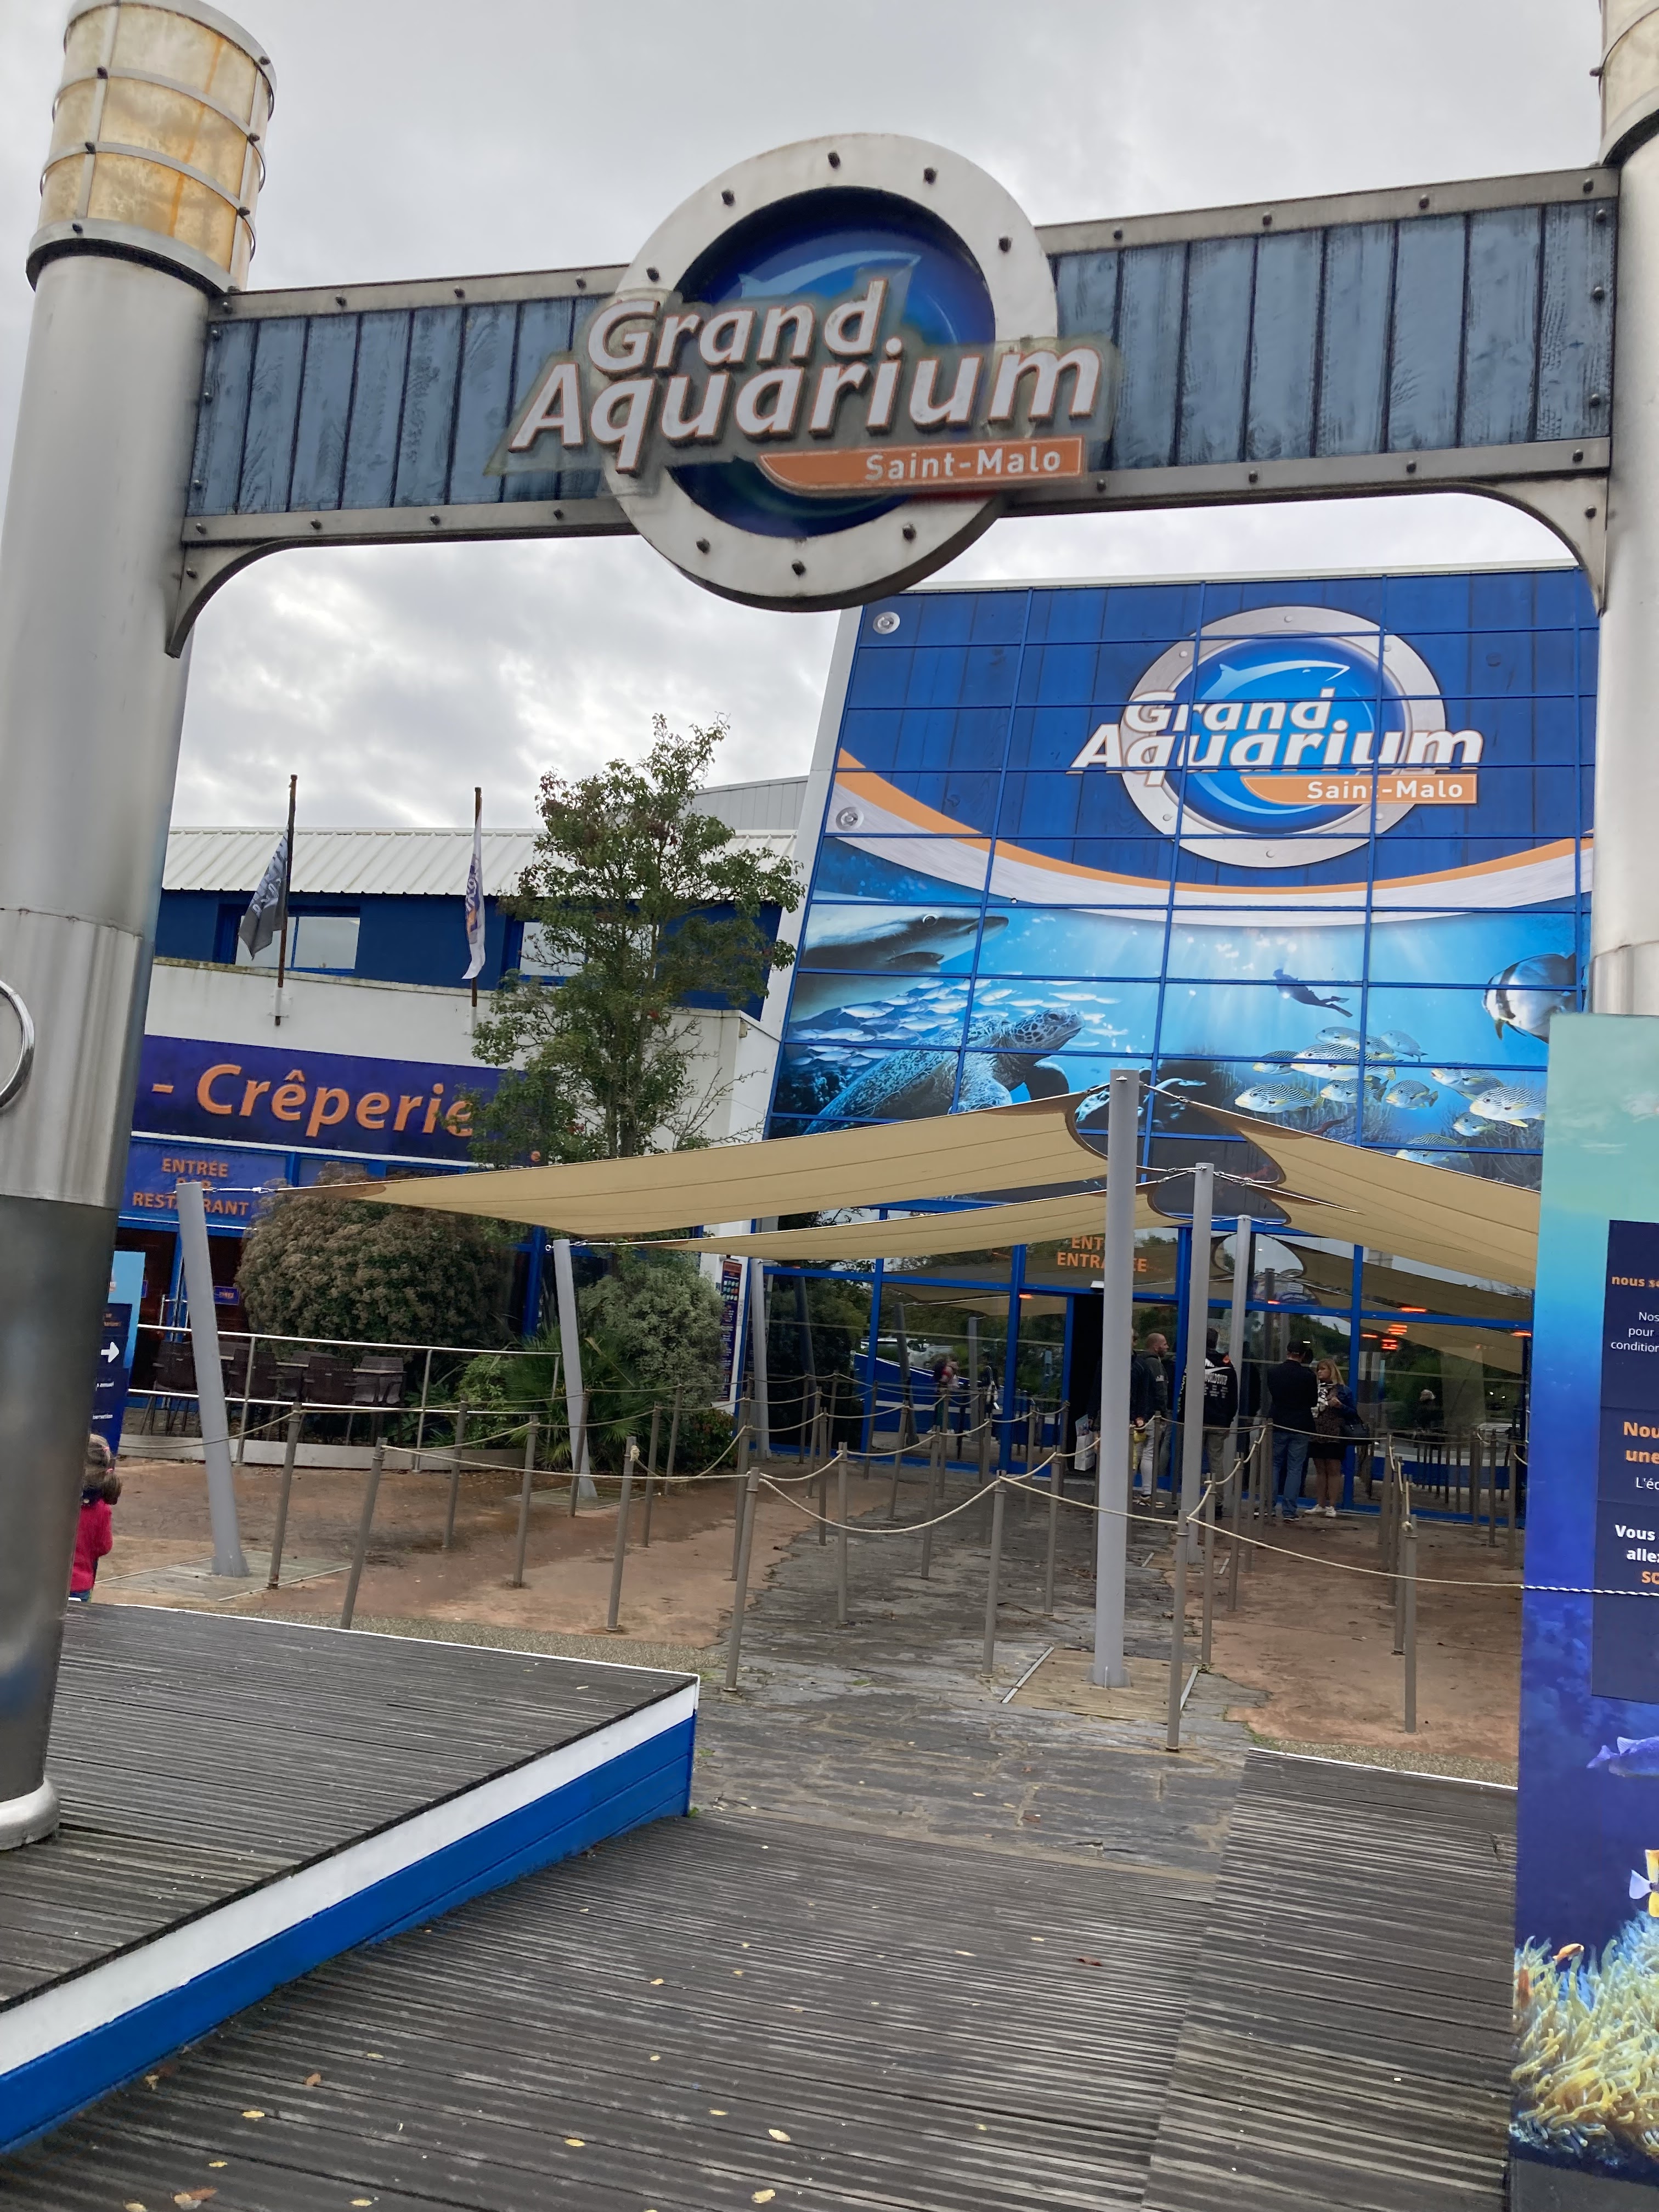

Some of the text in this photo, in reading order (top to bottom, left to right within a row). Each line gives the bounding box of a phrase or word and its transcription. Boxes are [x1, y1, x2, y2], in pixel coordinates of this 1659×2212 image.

[588, 276, 888, 375] Grand
[509, 335, 1102, 475] Aquarium
[865, 446, 1062, 482] Saint-Malo
[1124, 687, 1335, 733] Grand
[1066, 719, 1483, 787] Aquarium
[1307, 778, 1464, 800] Sain-Malo
[196, 1063, 473, 1137] Crêperie
[161, 1158, 229, 1178] ENTRÉE
[132, 1191, 250, 1216] RESTRANT
[1071, 1235, 1105, 1251] ENT
[1057, 1251, 1148, 1272] ENTRE
[1611, 1276, 1645, 1287] nous
[1628, 1328, 1655, 1338] pour
[1615, 1524, 1656, 1541] Vous
